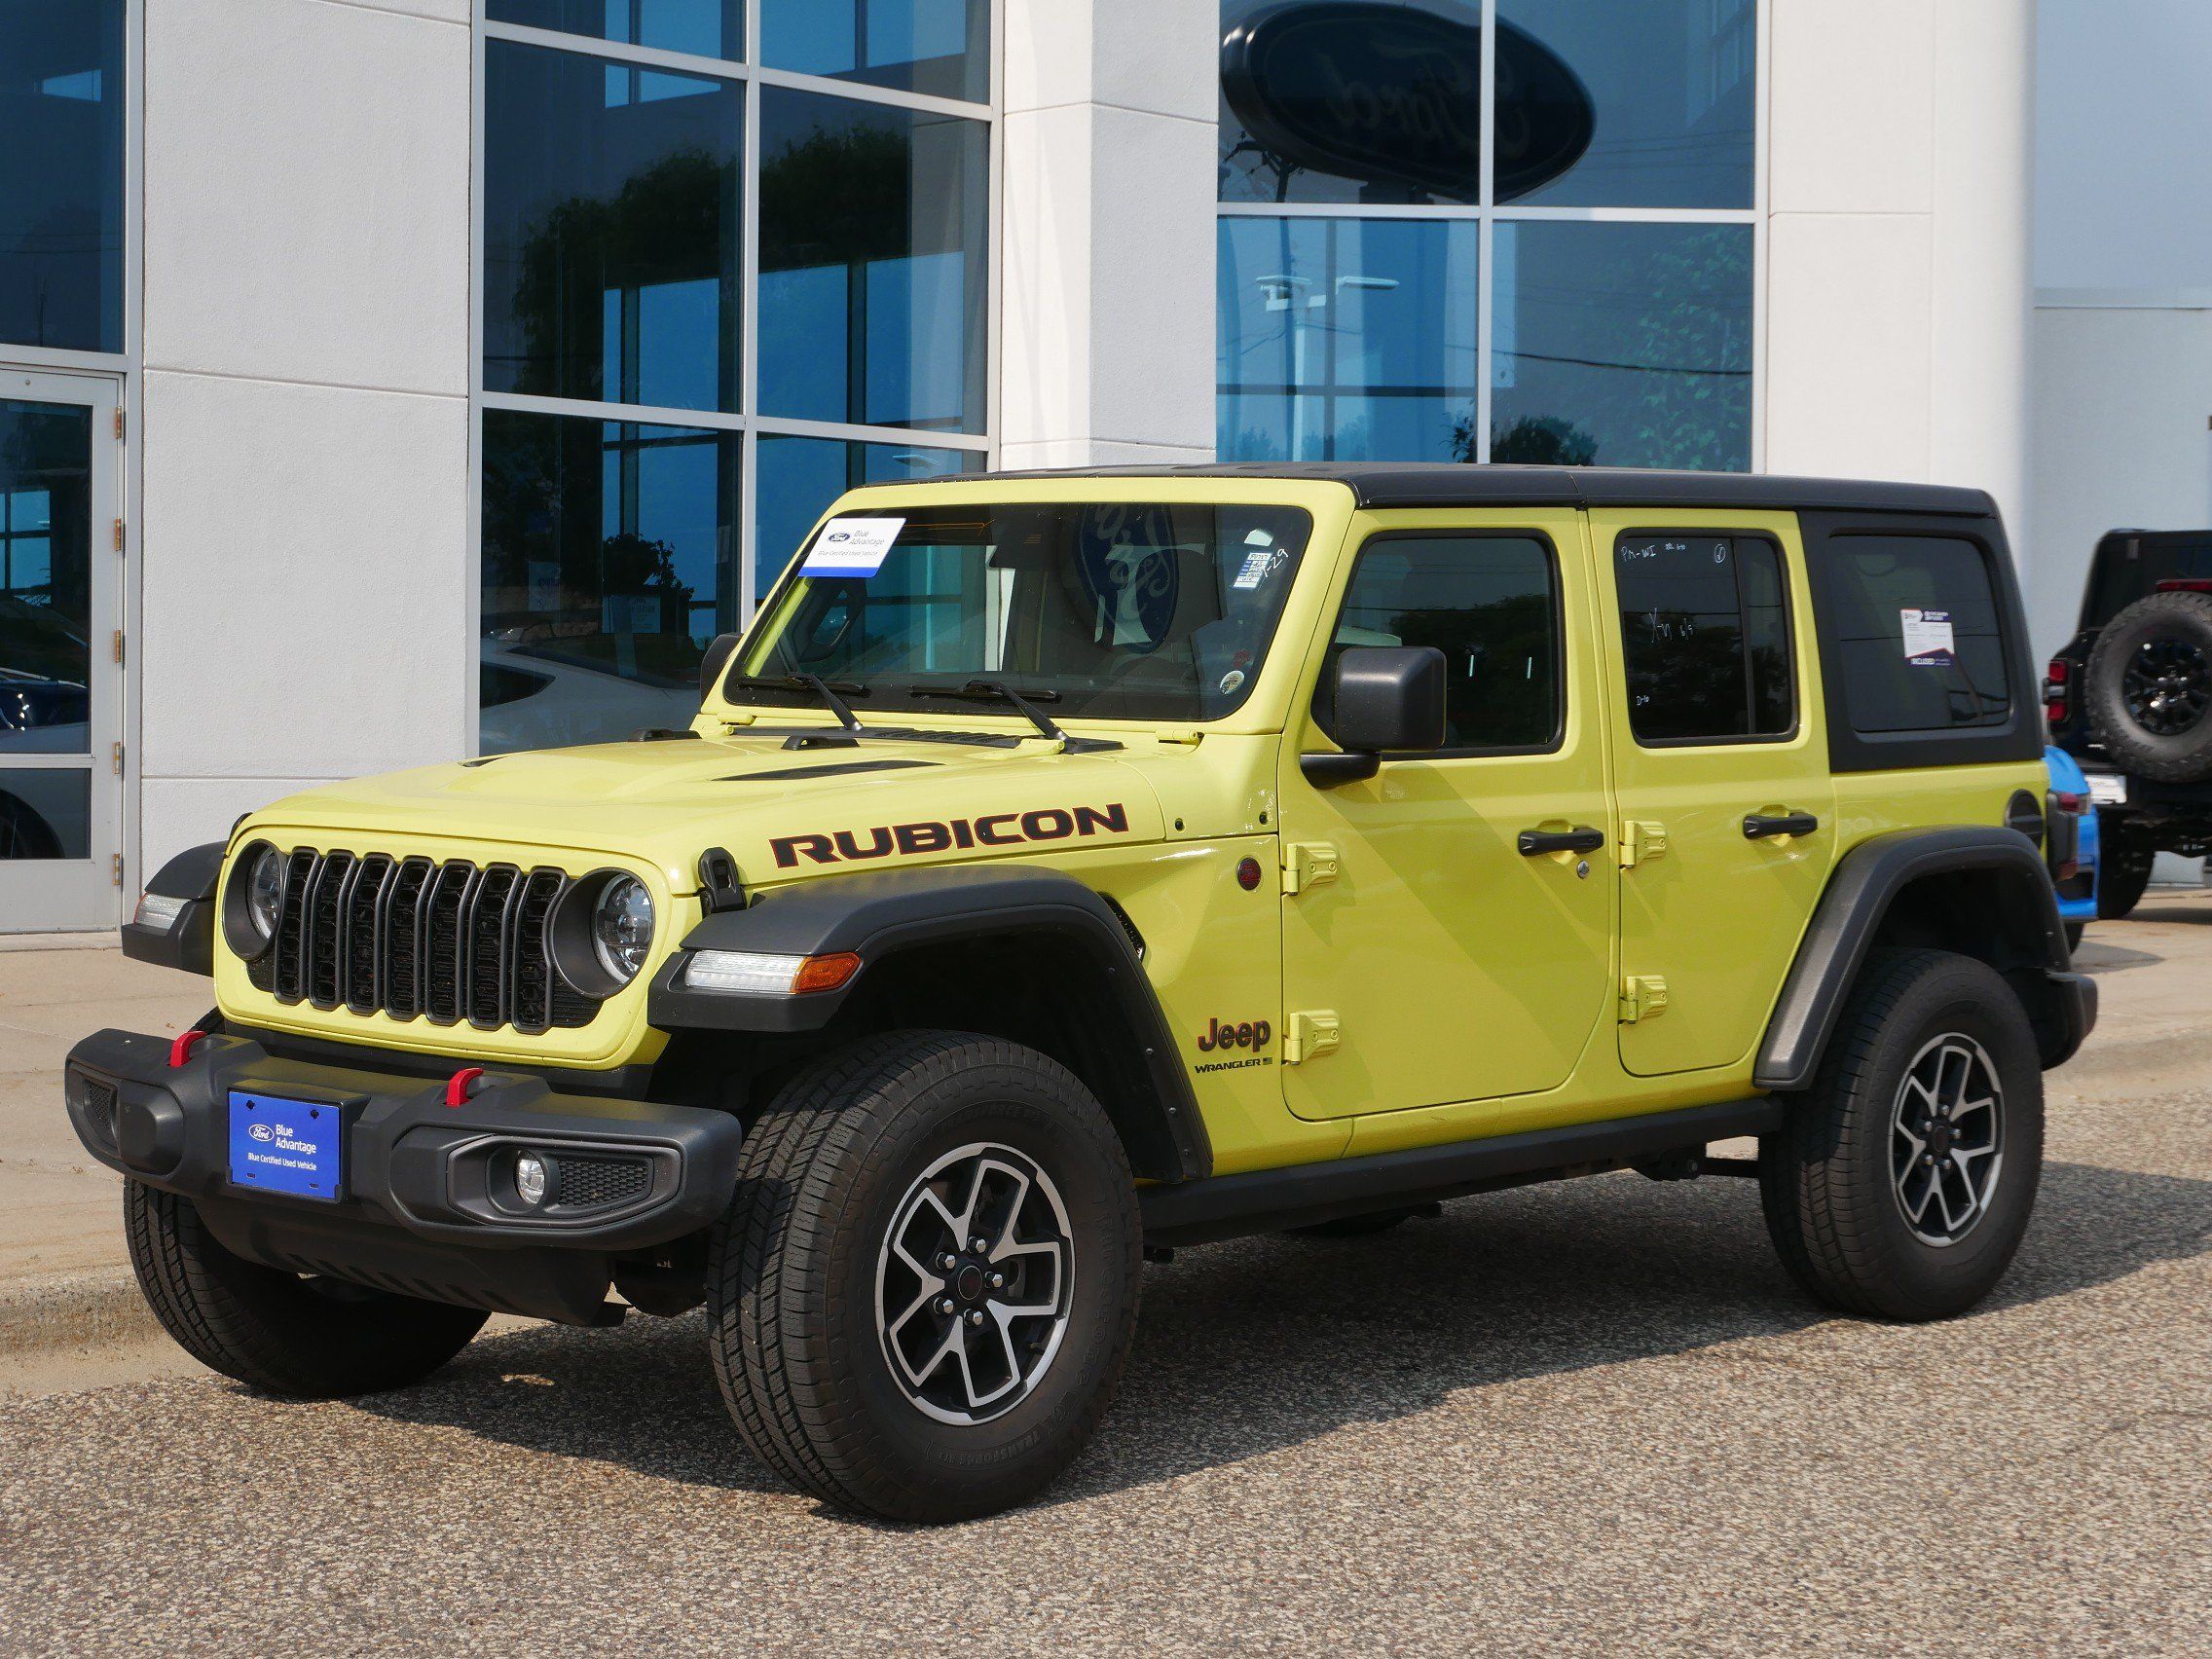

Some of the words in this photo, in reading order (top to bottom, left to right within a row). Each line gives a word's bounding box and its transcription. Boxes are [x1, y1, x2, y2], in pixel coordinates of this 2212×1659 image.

[849, 538, 885, 547] Advantage
[769, 803, 1129, 868] RUBICON
[1198, 1017, 1272, 1052] Jeep
[1195, 1058, 1261, 1074] WRANGLER
[276, 1124, 293, 1136] Blue
[276, 1137, 316, 1155] Advantage
[247, 1153, 260, 1161] Blue
[260, 1155, 281, 1165] Certified
[282, 1159, 296, 1167] Used
[298, 1161, 317, 1171] Vehicle
